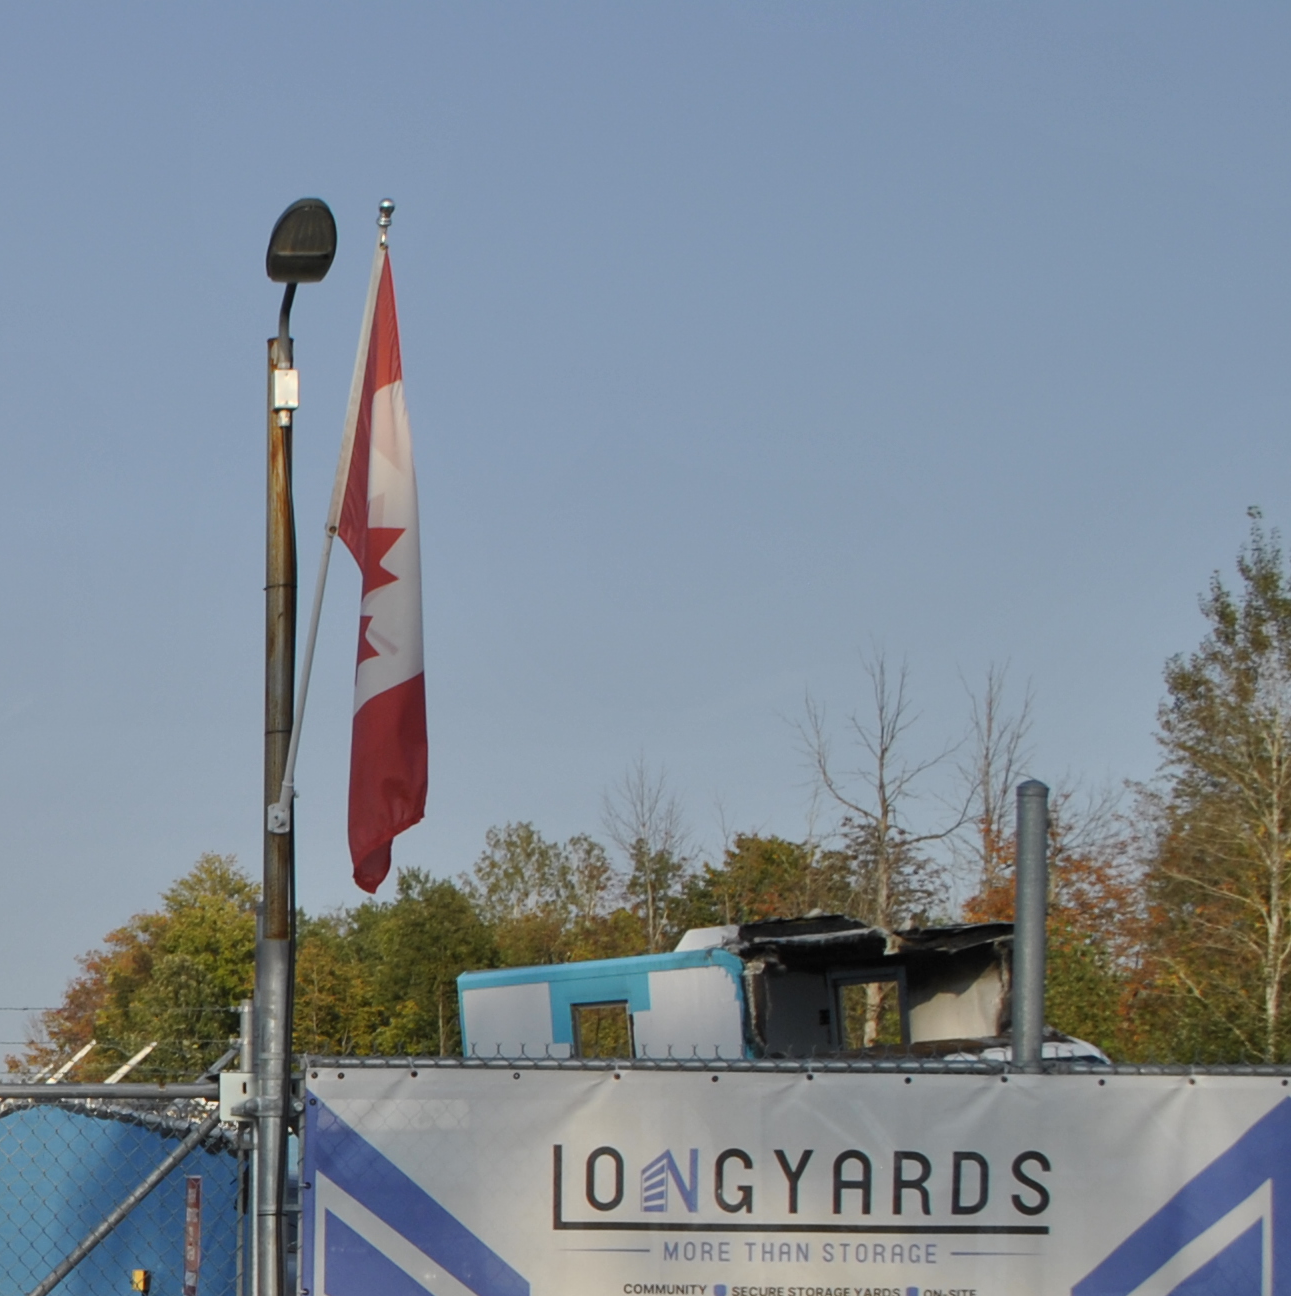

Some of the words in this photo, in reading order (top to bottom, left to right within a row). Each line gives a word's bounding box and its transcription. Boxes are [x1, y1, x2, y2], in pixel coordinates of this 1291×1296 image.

[553, 1144, 1051, 1234] LONGYARDS
[663, 1241, 731, 1262] MORE
[744, 1242, 810, 1263] THAN
[822, 1242, 937, 1264] STORAGE
[623, 1283, 707, 1296] COMMUNITY
